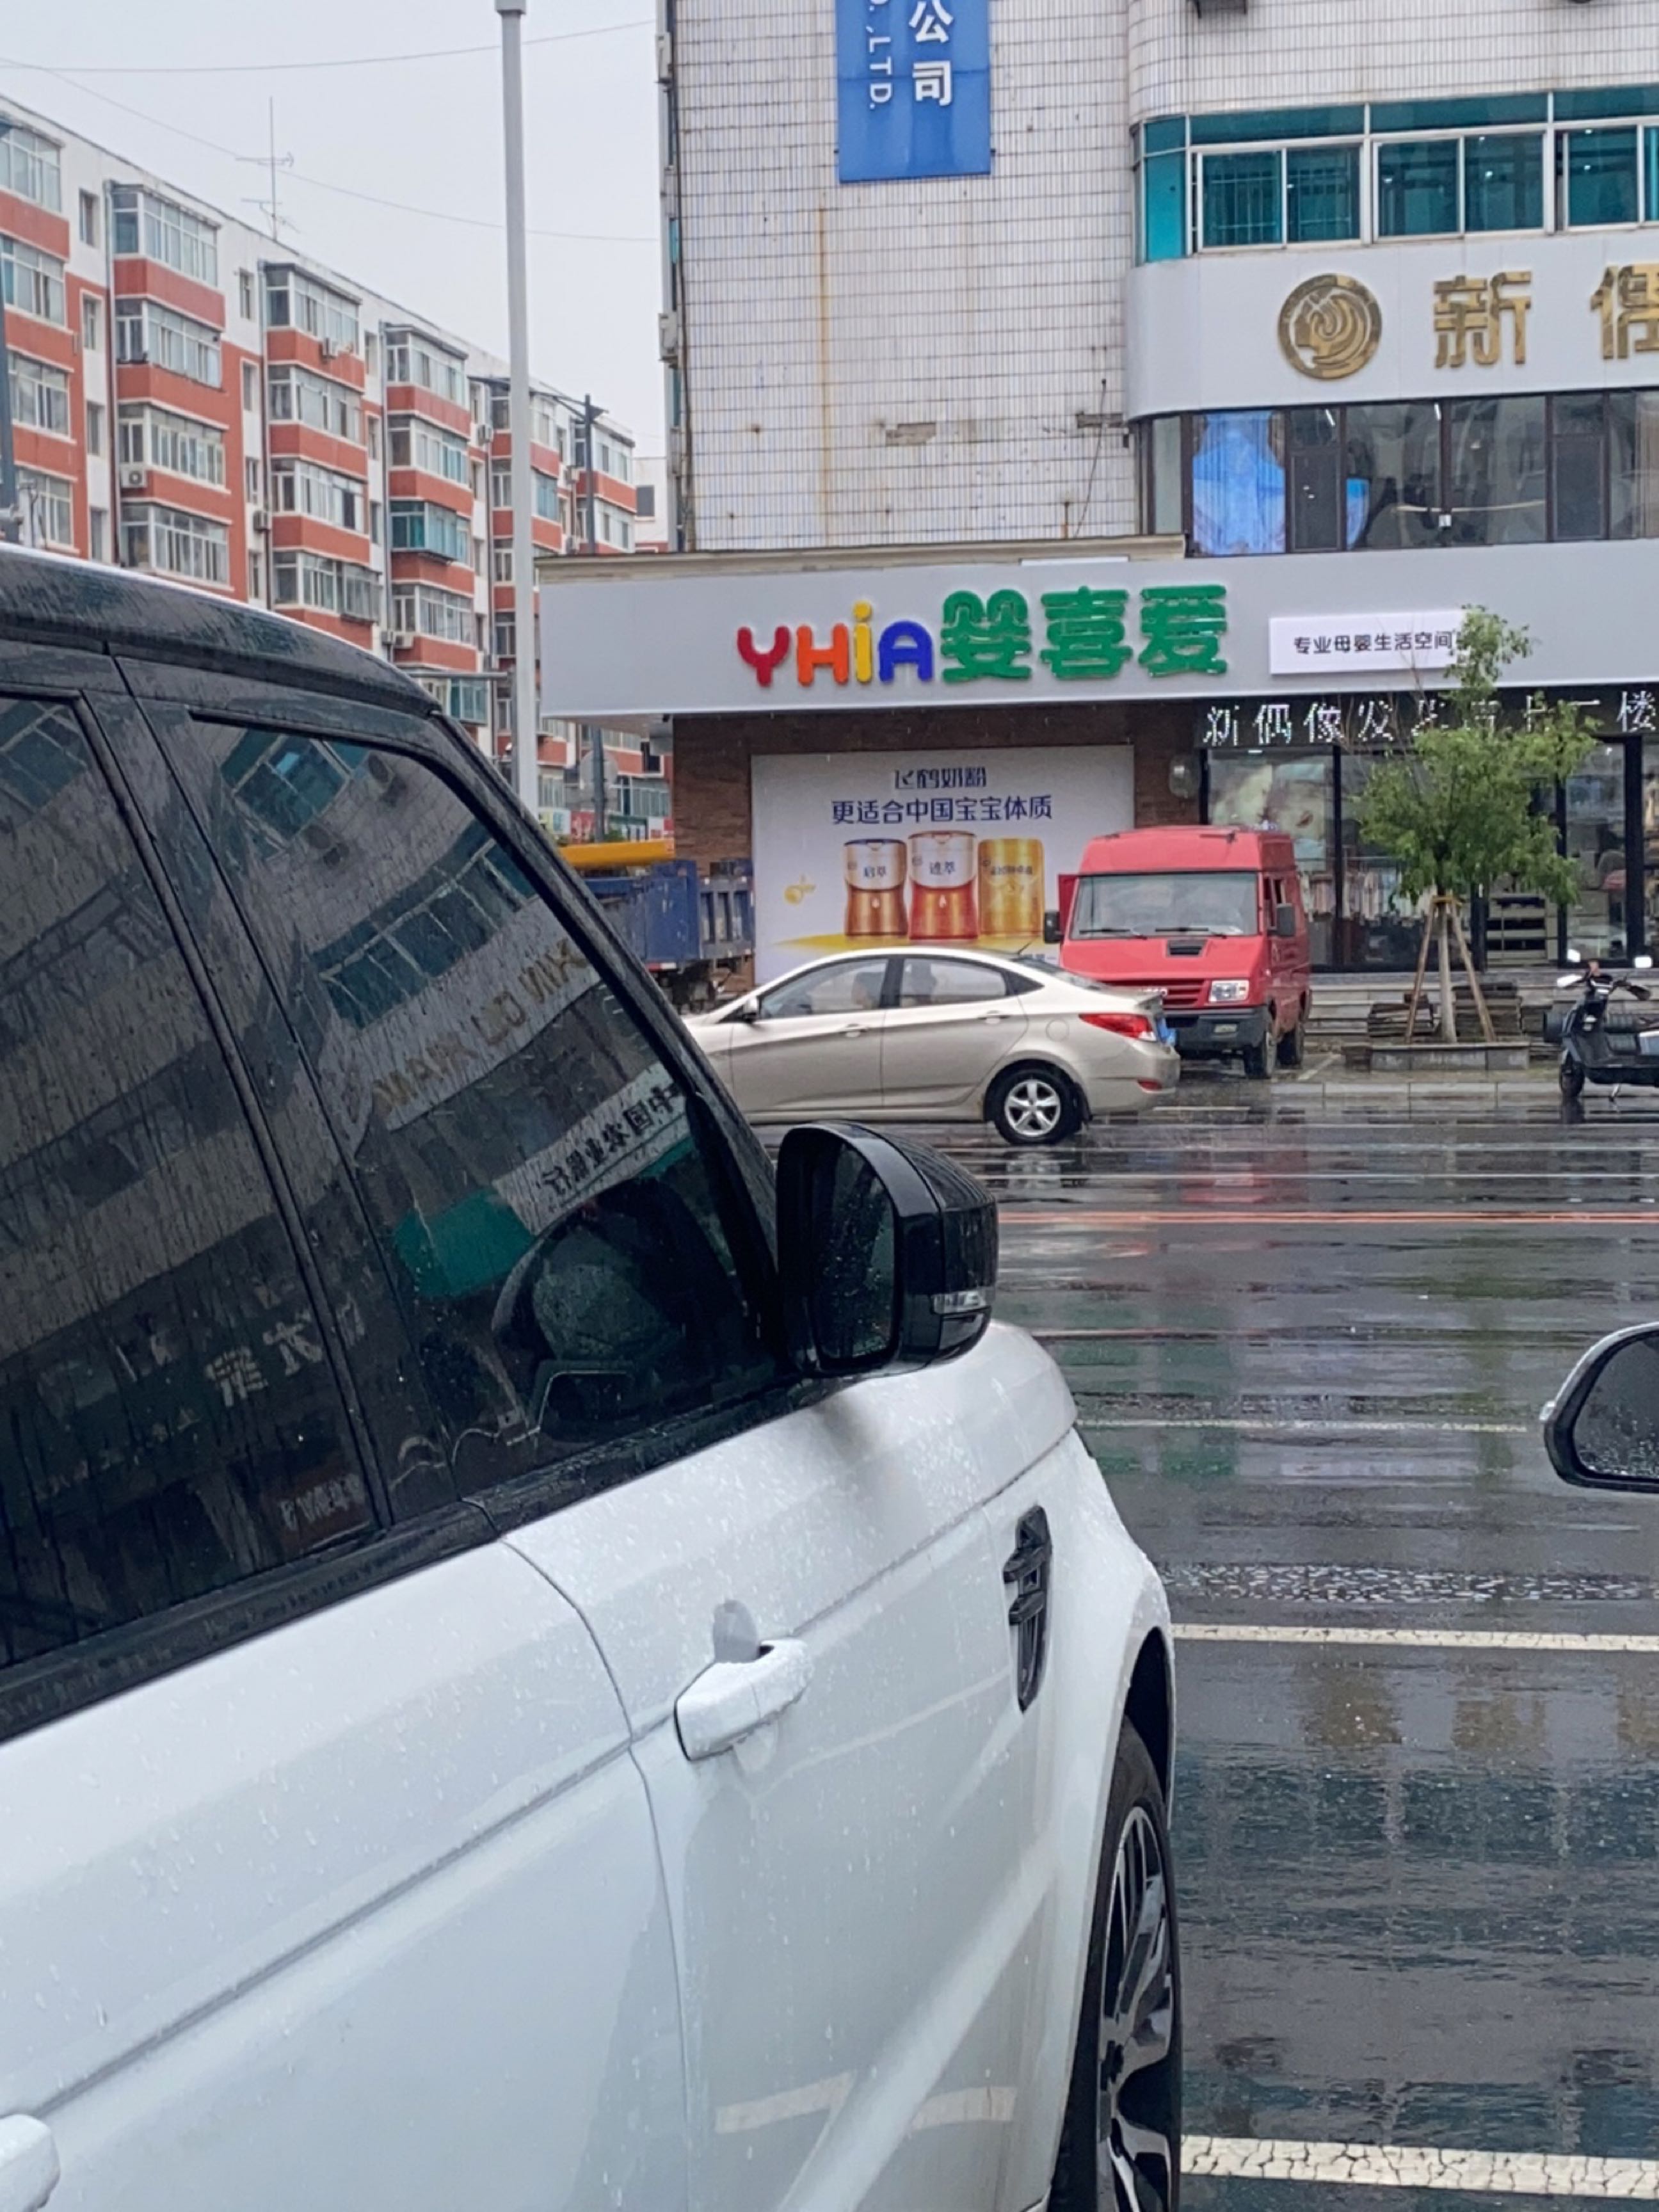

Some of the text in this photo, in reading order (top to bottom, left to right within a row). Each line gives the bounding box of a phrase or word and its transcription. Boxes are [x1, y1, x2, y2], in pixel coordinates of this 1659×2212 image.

[908, 0, 954, 106] 公司
[941, 585, 1228, 683] 婴喜爱
[1294, 630, 1452, 654] 专业母婴生活空间
[832, 794, 1053, 824] 更适合中国宝宝体质
